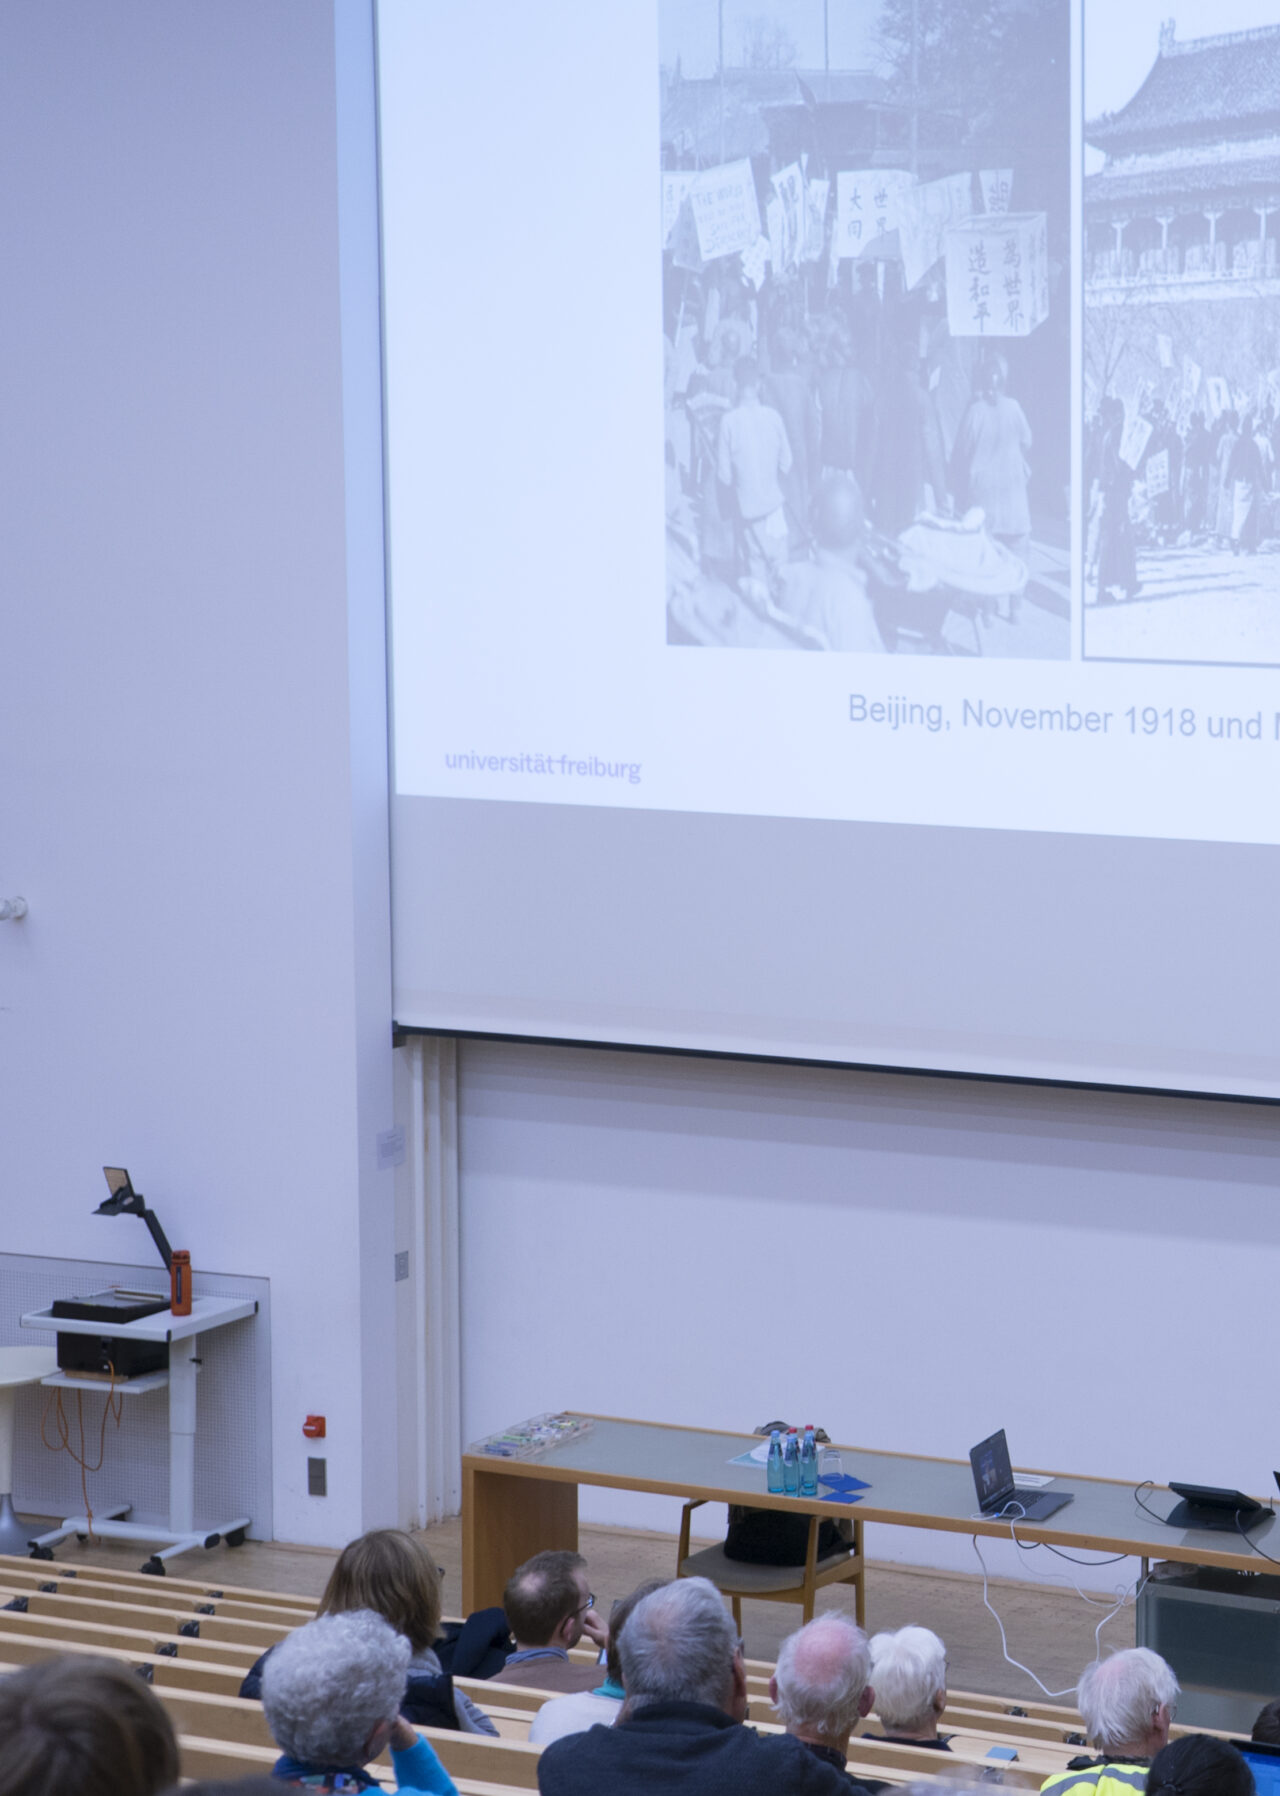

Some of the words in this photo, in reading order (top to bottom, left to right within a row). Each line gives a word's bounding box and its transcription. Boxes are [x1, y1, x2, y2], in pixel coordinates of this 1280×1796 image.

[848, 694, 951, 732] Beijing,
[962, 698, 1114, 735] November
[1124, 706, 1197, 738] 1918
[1206, 710, 1263, 741] und
